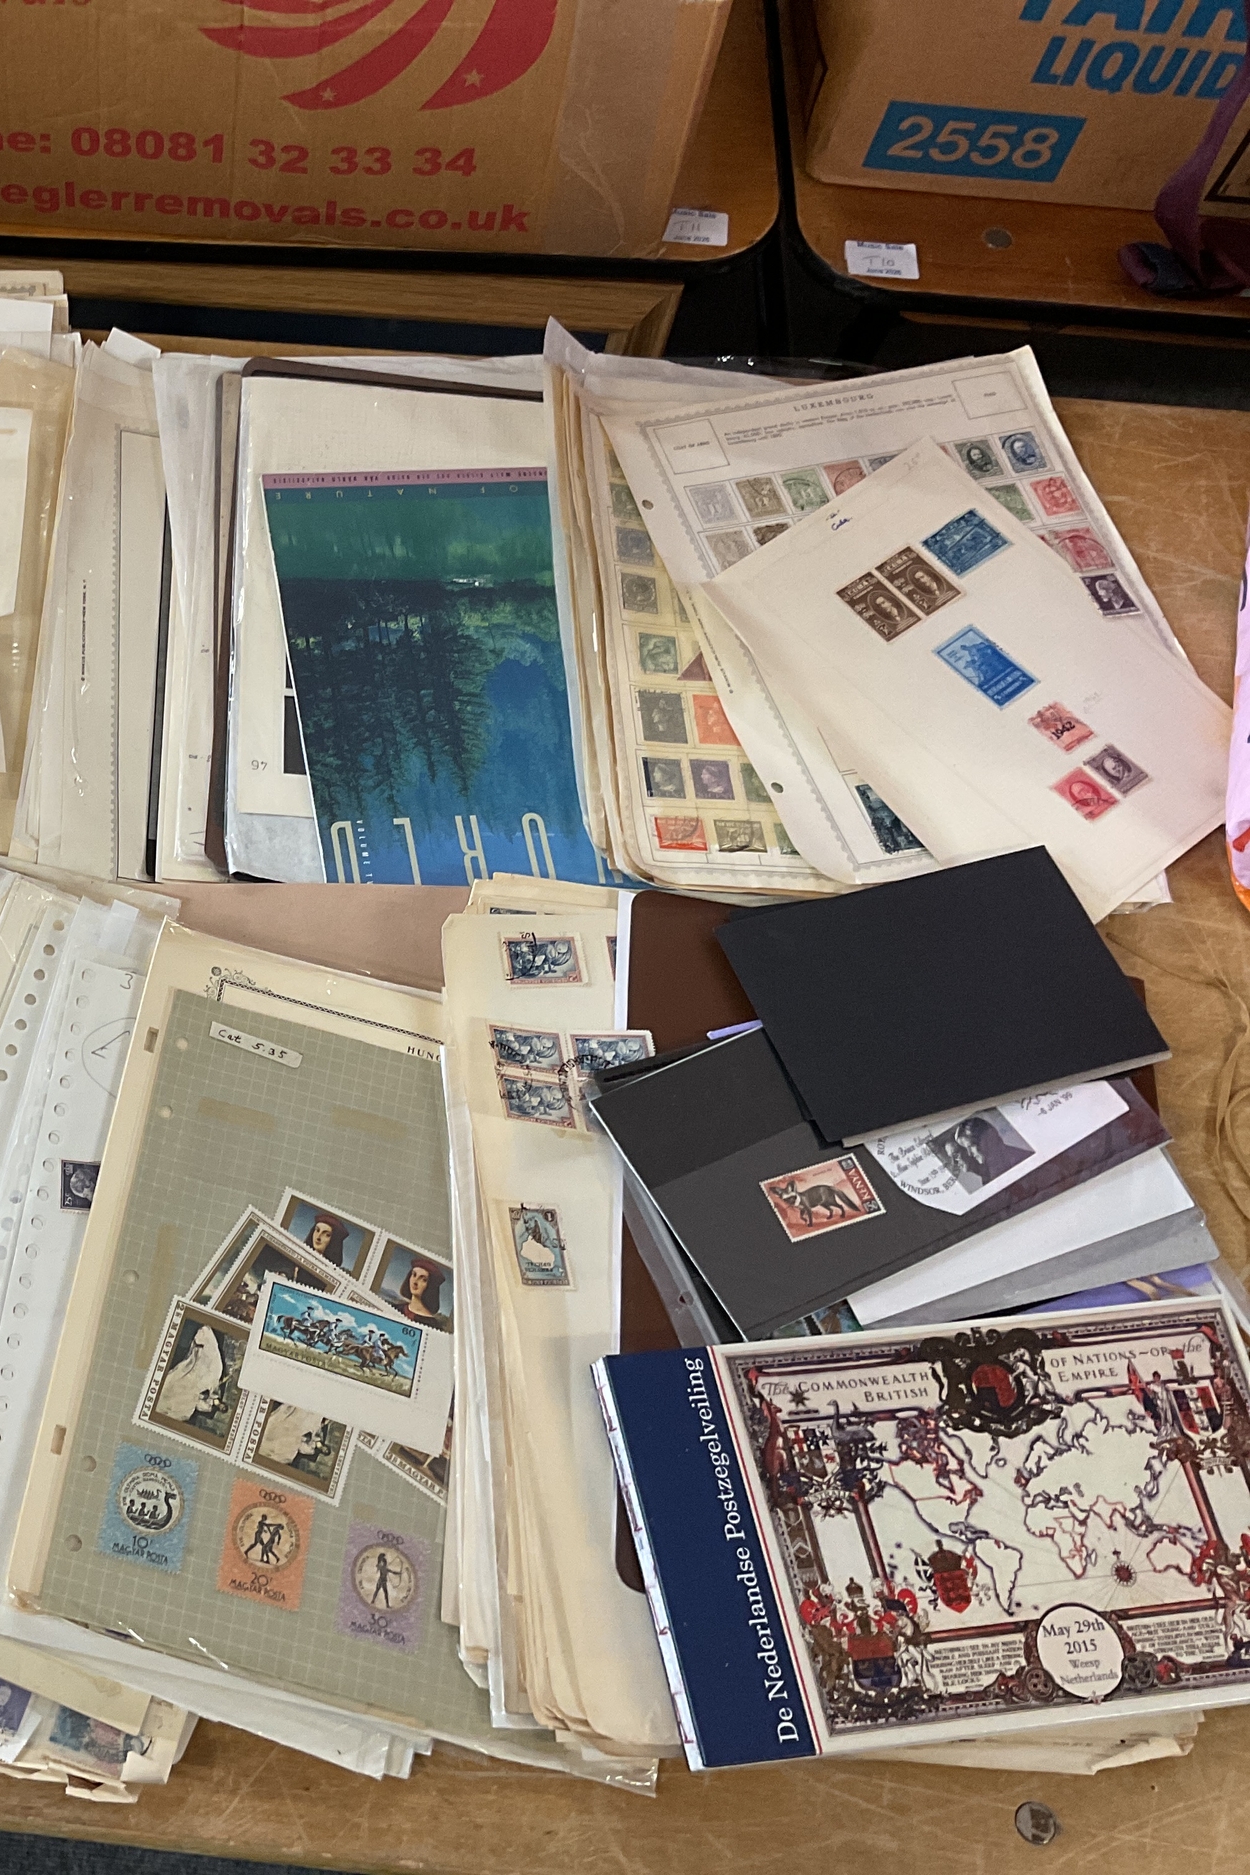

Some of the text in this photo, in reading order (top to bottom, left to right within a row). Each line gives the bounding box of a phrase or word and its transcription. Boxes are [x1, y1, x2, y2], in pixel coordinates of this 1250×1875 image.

[70, 126, 226, 164] 08081
[248, 139, 310, 174] 32
[328, 145, 393, 176] 33
[411, 147, 477, 177] 34
[886, 115, 1059, 170] 2558
[794, 394, 875, 412] LUXEMBOURG
[275, 488, 436, 500] NATURE
[1051, 720, 1076, 740] 1942
[330, 812, 608, 886] ORLD
[217, 1028, 288, 1060] Cat 5.35
[847, 1168, 873, 1200] KENYA
[402, 1327, 416, 1338] 60
[797, 1369, 930, 1395] COMMONWEALTH
[1050, 1356, 1068, 1369] OF
[864, 1367, 1119, 1404] BRITISH EMPIRE
[141, 1378, 160, 1419] POSTA
[112, 1542, 169, 1566] MAGYAR POSTA
[684, 1357, 799, 1742] De Nederlandse Postzegelveiling
[229, 1578, 286, 1602] MAGYAR POSTA
[350, 1622, 407, 1645] MAGYAR POSTA
[1042, 1618, 1105, 1638] May 29th
[1064, 1639, 1097, 1655] 2015
[1069, 1659, 1100, 1669] Weesp
[1060, 1669, 1119, 1685] Netherlands
